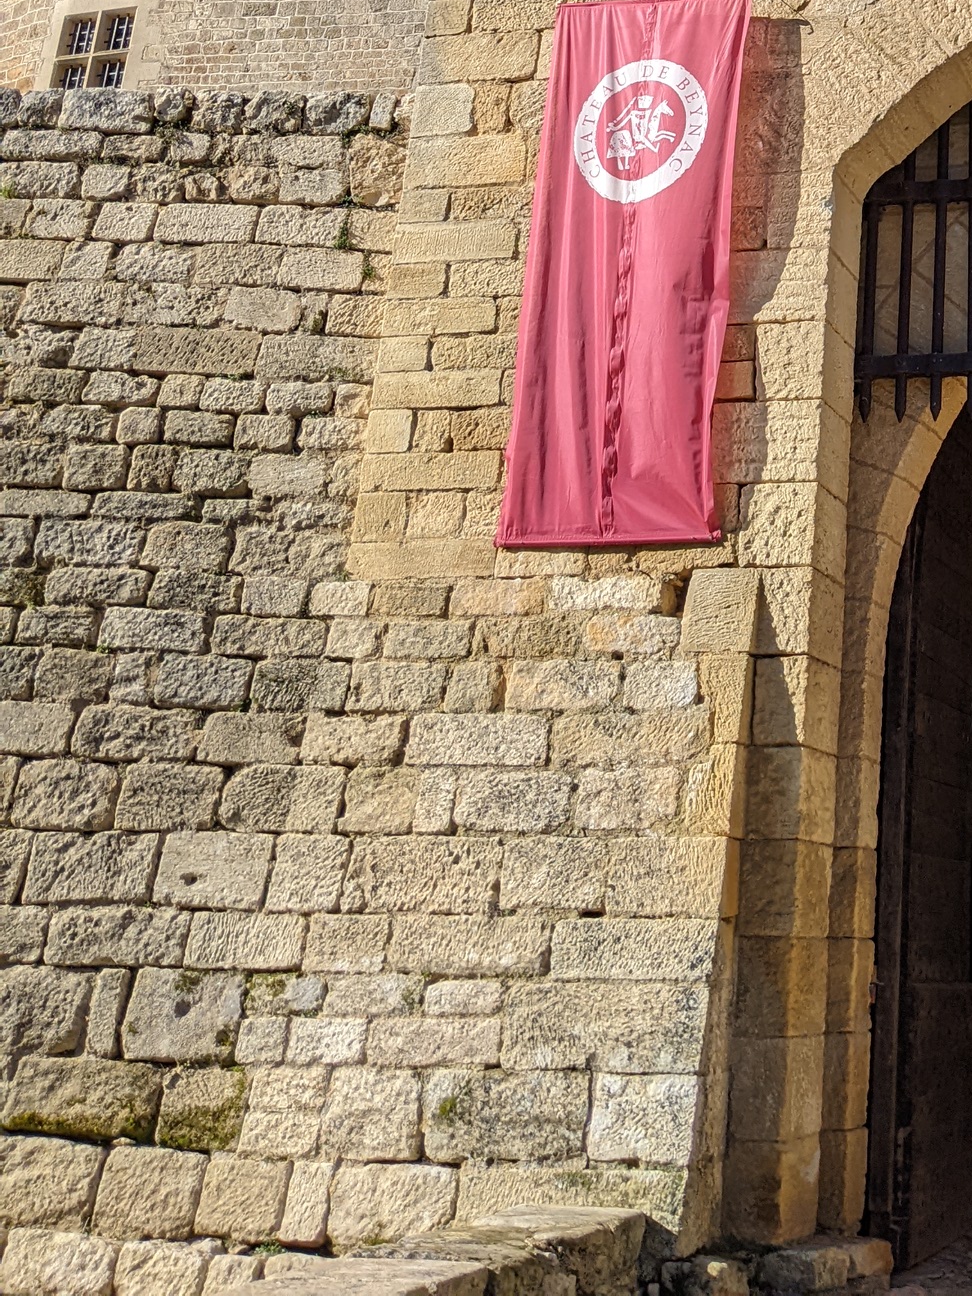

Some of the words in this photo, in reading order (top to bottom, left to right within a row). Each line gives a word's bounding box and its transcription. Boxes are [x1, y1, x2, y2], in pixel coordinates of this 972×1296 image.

[580, 72, 627, 179] CHATEAU
[642, 65, 670, 79] DE
[668, 77, 704, 173] BEYNAC
